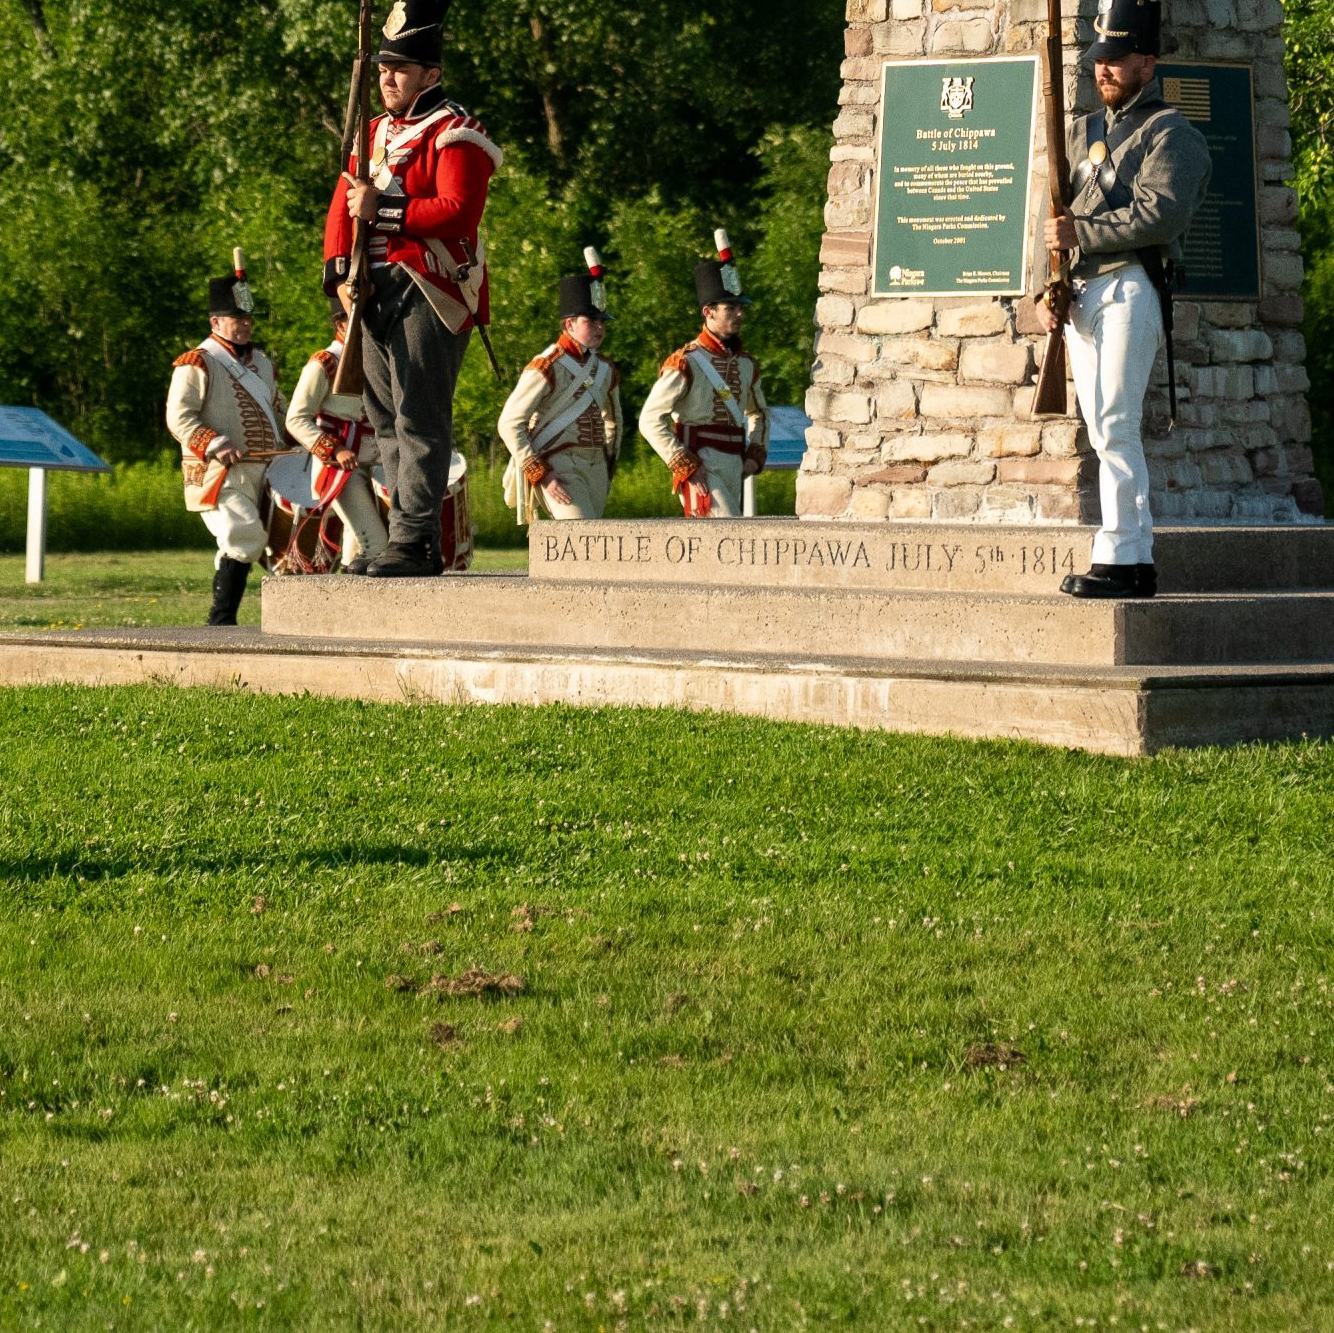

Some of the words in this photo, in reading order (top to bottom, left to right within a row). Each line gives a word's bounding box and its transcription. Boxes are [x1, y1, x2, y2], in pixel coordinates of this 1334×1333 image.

[916, 129, 941, 139] Battle
[943, 128, 953, 138] of
[954, 128, 995, 139] Chippawa
[932, 142, 936, 151] 5
[938, 141, 956, 152] July
[959, 140, 978, 150] 1814
[989, 177, 1012, 185] prevailed
[999, 214, 1006, 222] by
[902, 268, 924, 279] Niagara
[545, 536, 651, 562] BATTLE
[666, 536, 702, 563] OF
[717, 537, 870, 567] CHIPPAWA
[887, 542, 961, 572] JULY
[975, 545, 1004, 572] 5th
[1021, 546, 1075, 574] 1814
